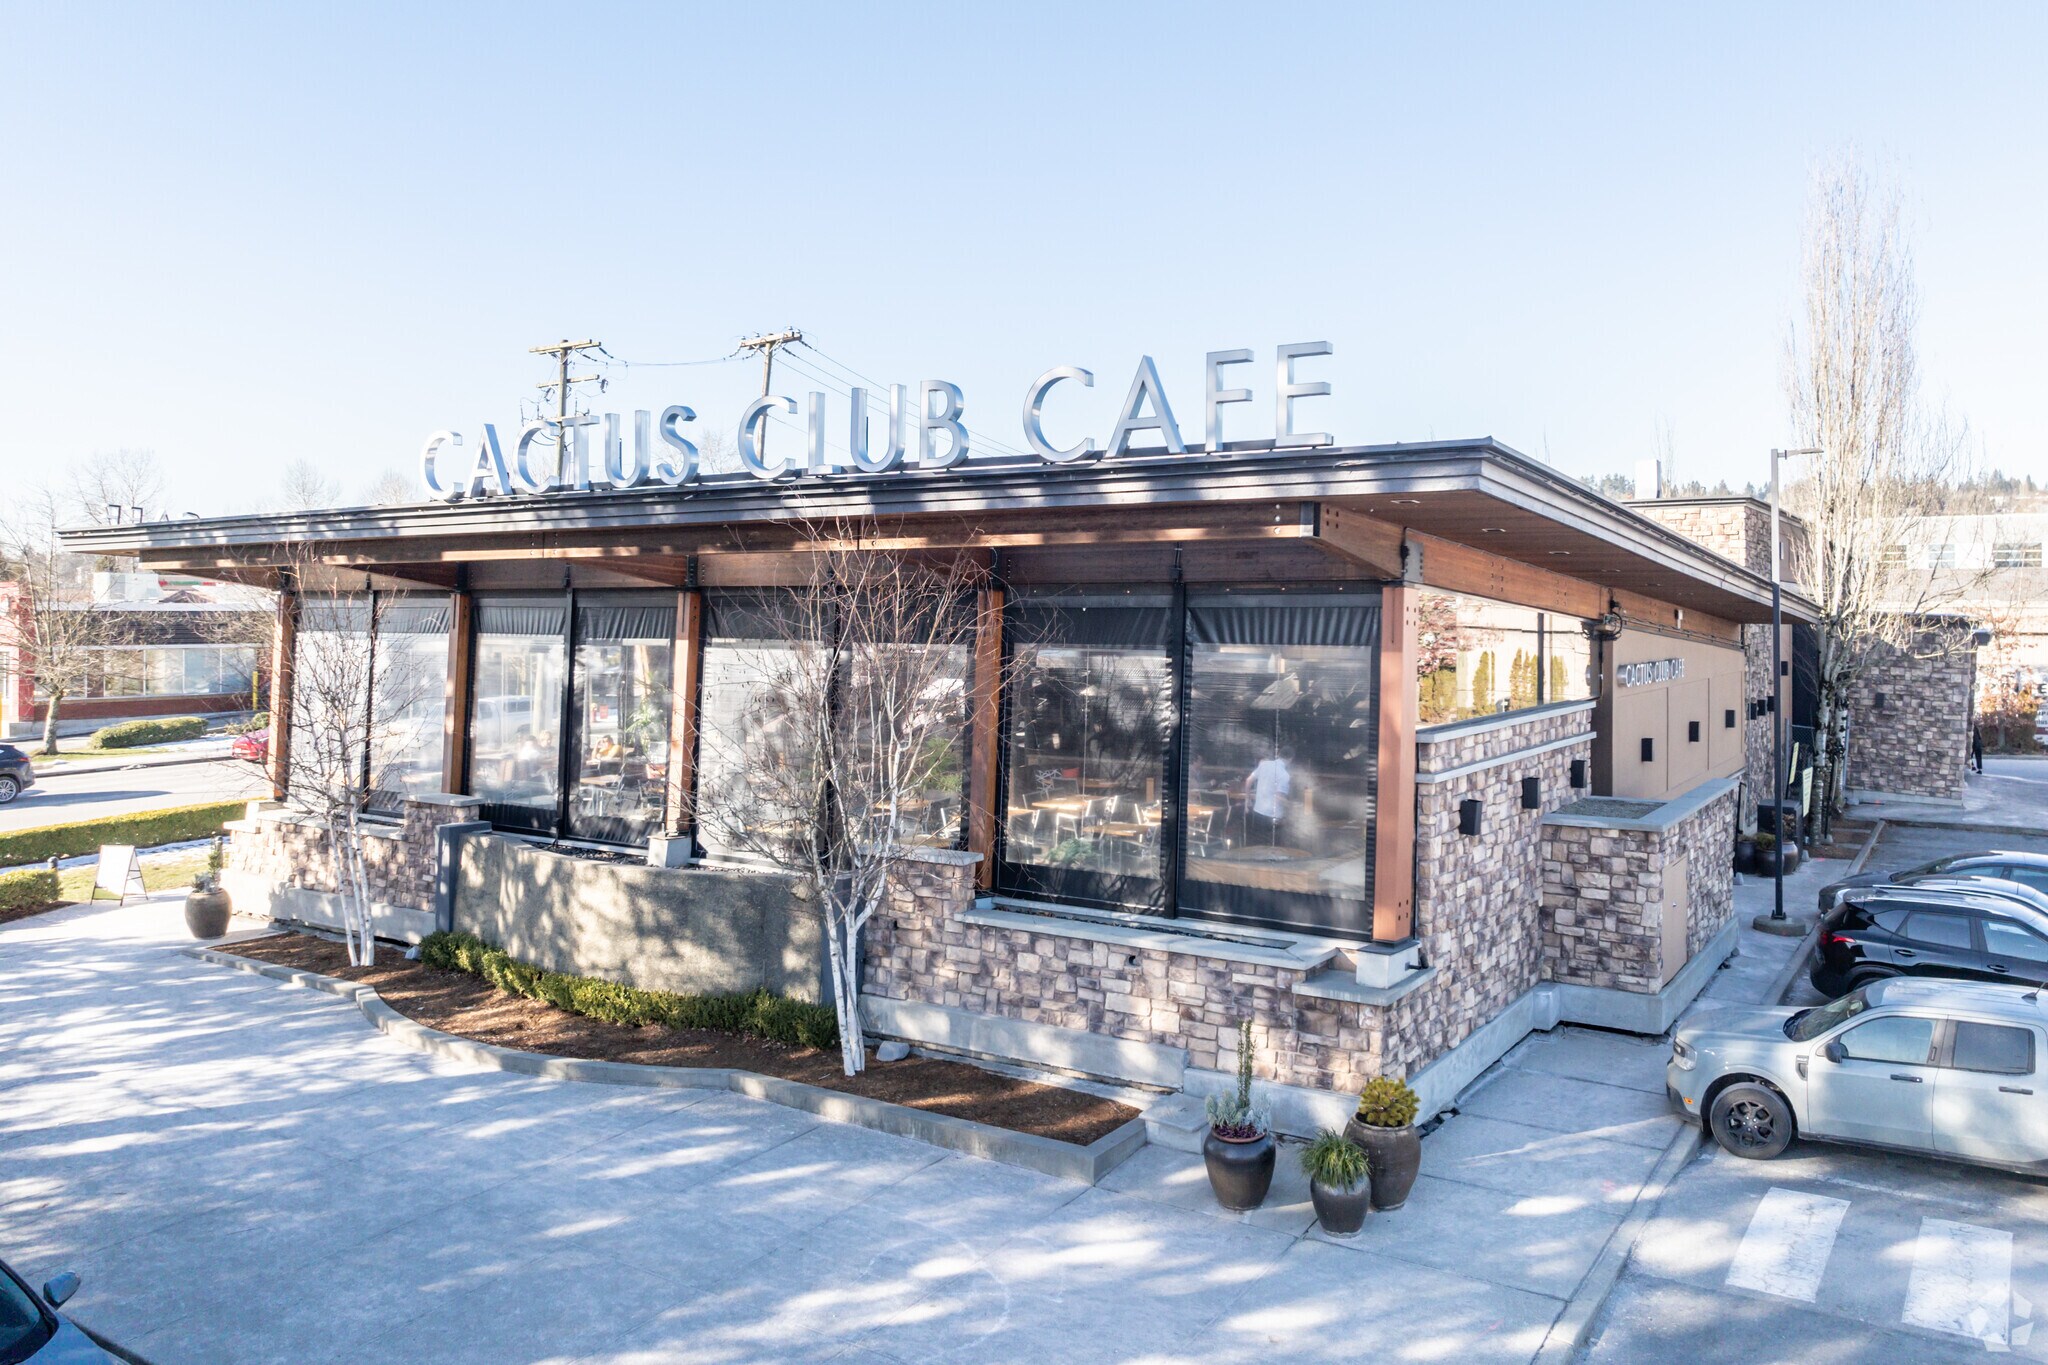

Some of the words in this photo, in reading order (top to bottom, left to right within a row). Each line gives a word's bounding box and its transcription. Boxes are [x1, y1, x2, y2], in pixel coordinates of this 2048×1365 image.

[420, 405, 698, 500] CACTUS
[737, 379, 970, 480] CLUB
[1022, 340, 1334, 463] CAFE
[1625, 663, 1653, 688] CACTUS
[1654, 660, 1670, 682] CLUB
[1671, 658, 1685, 680] CAFE
